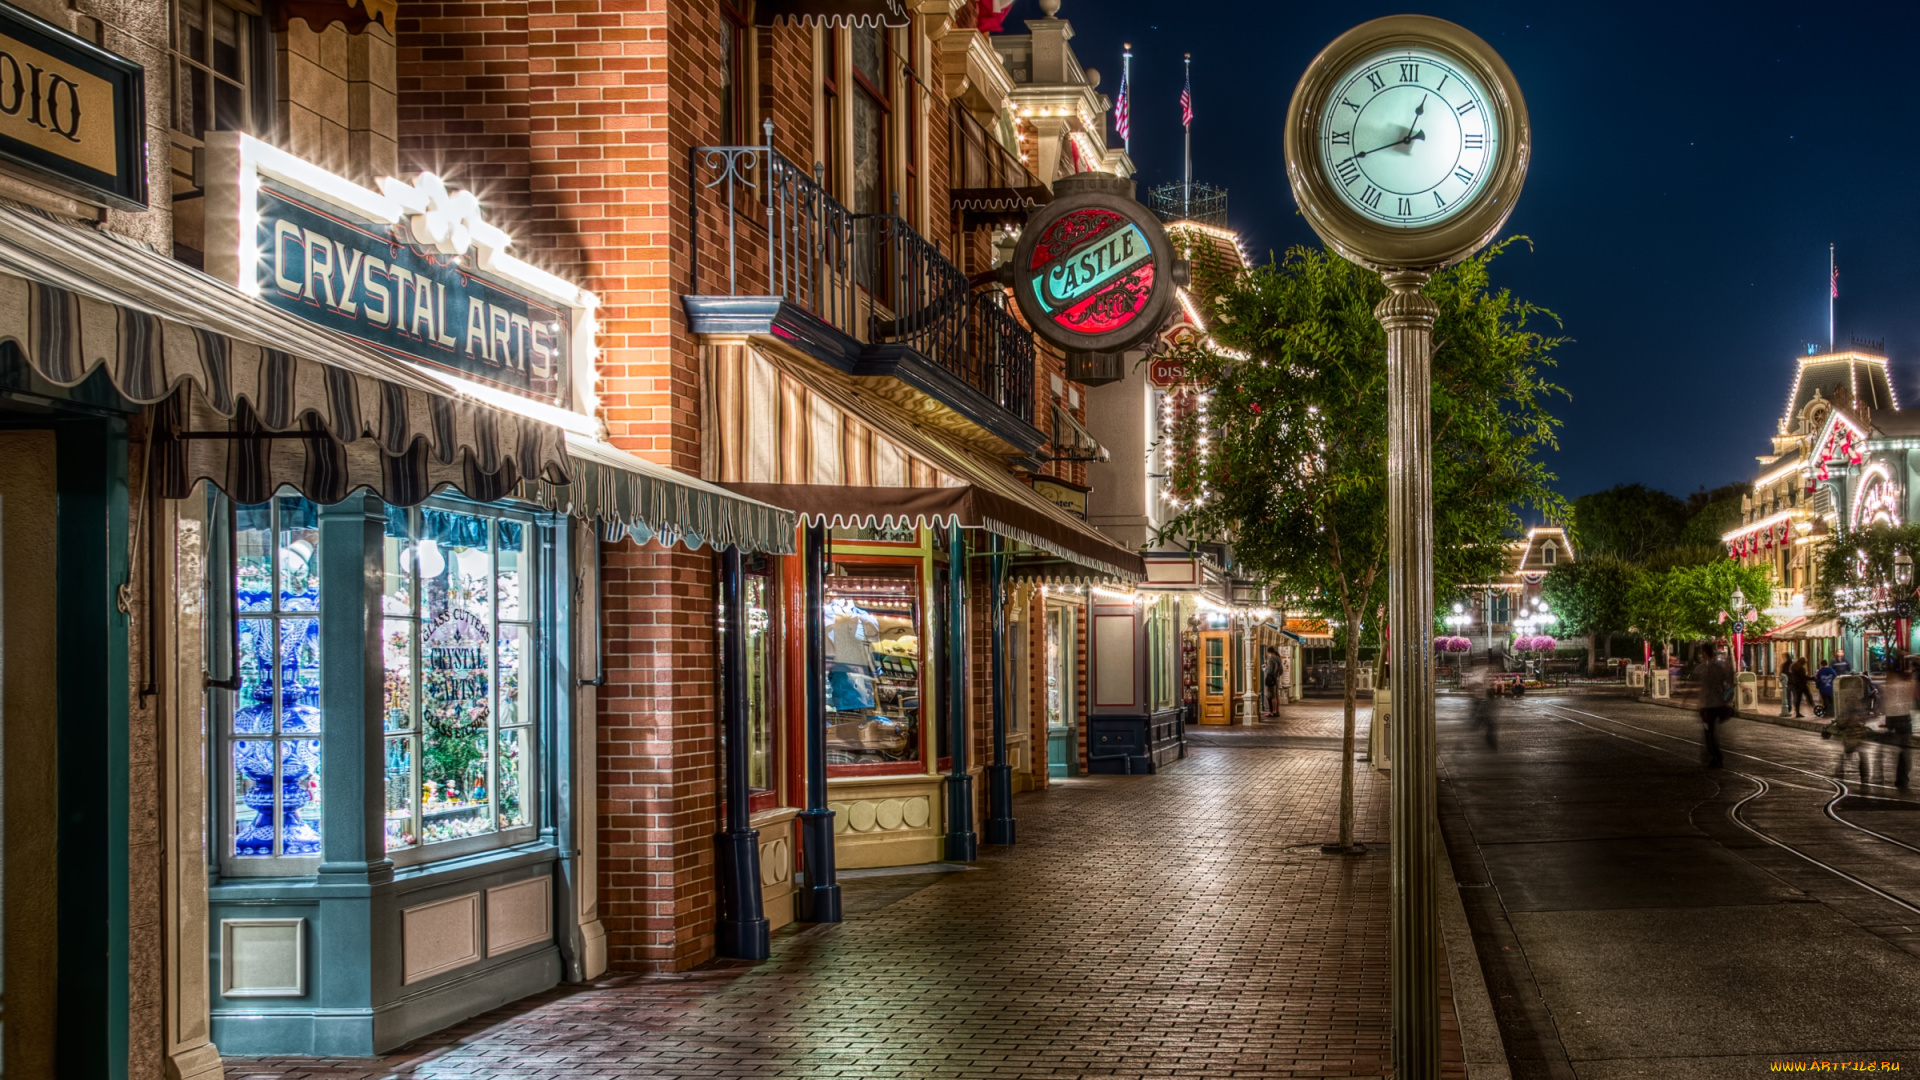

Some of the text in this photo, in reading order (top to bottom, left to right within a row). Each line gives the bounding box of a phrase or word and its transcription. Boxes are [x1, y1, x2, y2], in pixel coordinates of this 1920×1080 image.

[1366, 71, 1386, 92] XI
[1399, 64, 1419, 82] XII
[1437, 75, 1449, 91] I
[1342, 97, 1360, 113] X
[1456, 100, 1475, 116] II
[1332, 131, 1349, 145] IX
[1465, 134, 1483, 149] III
[1335, 159, 1361, 187] VIII
[1454, 165, 1474, 185] IV
[1360, 185, 1382, 209] VII
[1398, 198, 1412, 216] VI
[1433, 191, 1446, 208] V
[1041, 229, 1134, 307] CASTLE
[274, 219, 551, 378] CRYSTAL ARTS
[423, 608, 490, 644] GLASS CUTTERS
[430, 647, 488, 670] CRYSTAL
[441, 678, 477, 701] ARTS
[424, 705, 491, 739] GLASS ETCHING
